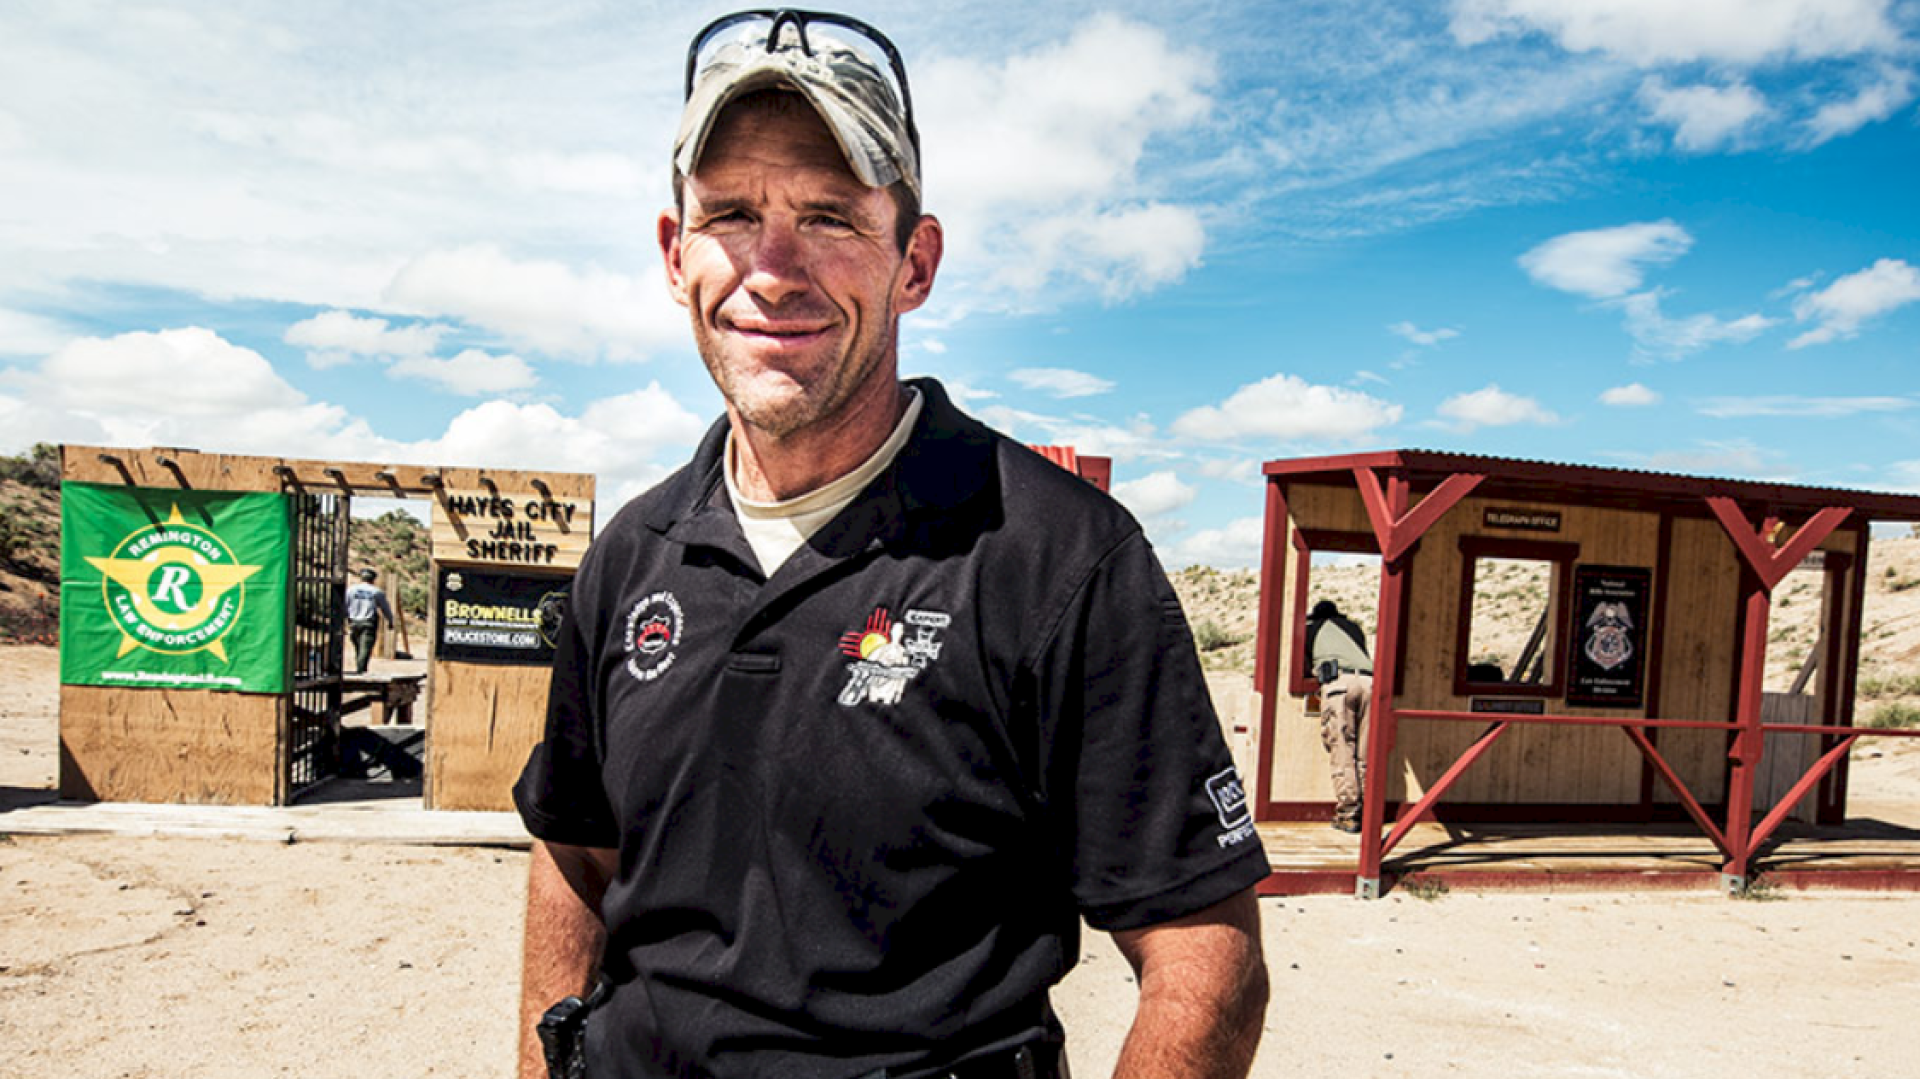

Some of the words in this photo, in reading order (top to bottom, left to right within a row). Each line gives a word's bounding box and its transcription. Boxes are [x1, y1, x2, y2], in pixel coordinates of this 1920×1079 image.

[448, 495, 514, 518] HAYES
[525, 500, 576, 523] CITY
[488, 519, 536, 541] JAIL
[128, 531, 221, 561] REMINGTON
[467, 539, 559, 563] SHERIFF
[151, 566, 199, 611] R
[115, 595, 139, 624] LAW
[136, 596, 234, 645] ENFORCEMENT
